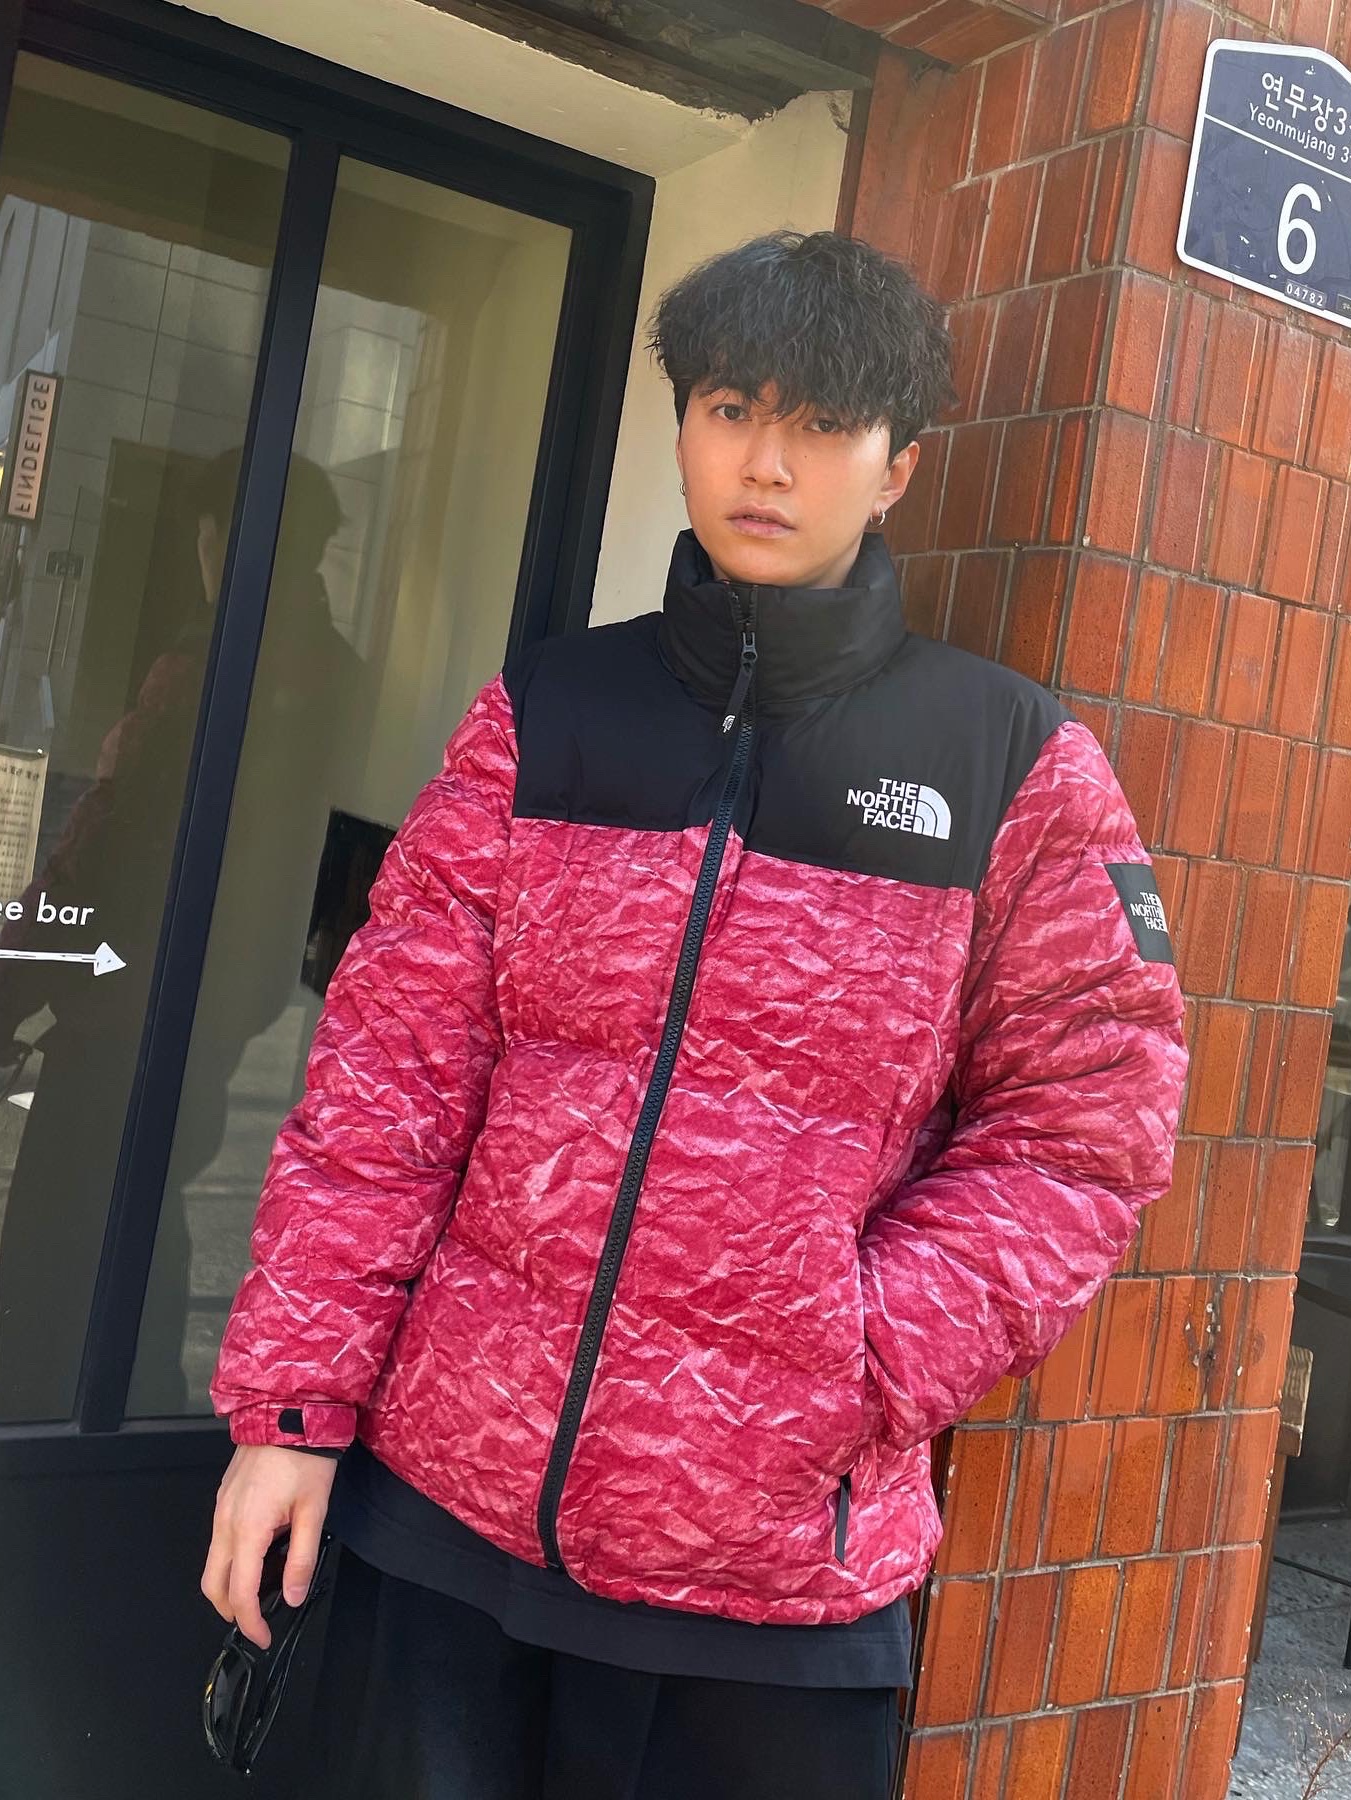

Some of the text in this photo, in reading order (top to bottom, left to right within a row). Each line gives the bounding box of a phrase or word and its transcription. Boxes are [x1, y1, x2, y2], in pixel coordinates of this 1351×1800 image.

[1261, 72, 1351, 135] 연무장3
[1249, 102, 1351, 163] Yeonmujang 3
[1277, 183, 1322, 275] 6
[1286, 283, 1324, 306] 04782
[846, 788, 916, 815] NORTH
[879, 778, 919, 800] THE
[862, 807, 914, 832] FACE
[36, 891, 95, 926] bar
[1129, 903, 1162, 918] NORTH
[1140, 892, 1159, 905] THE
[1144, 917, 1165, 931] FACE
